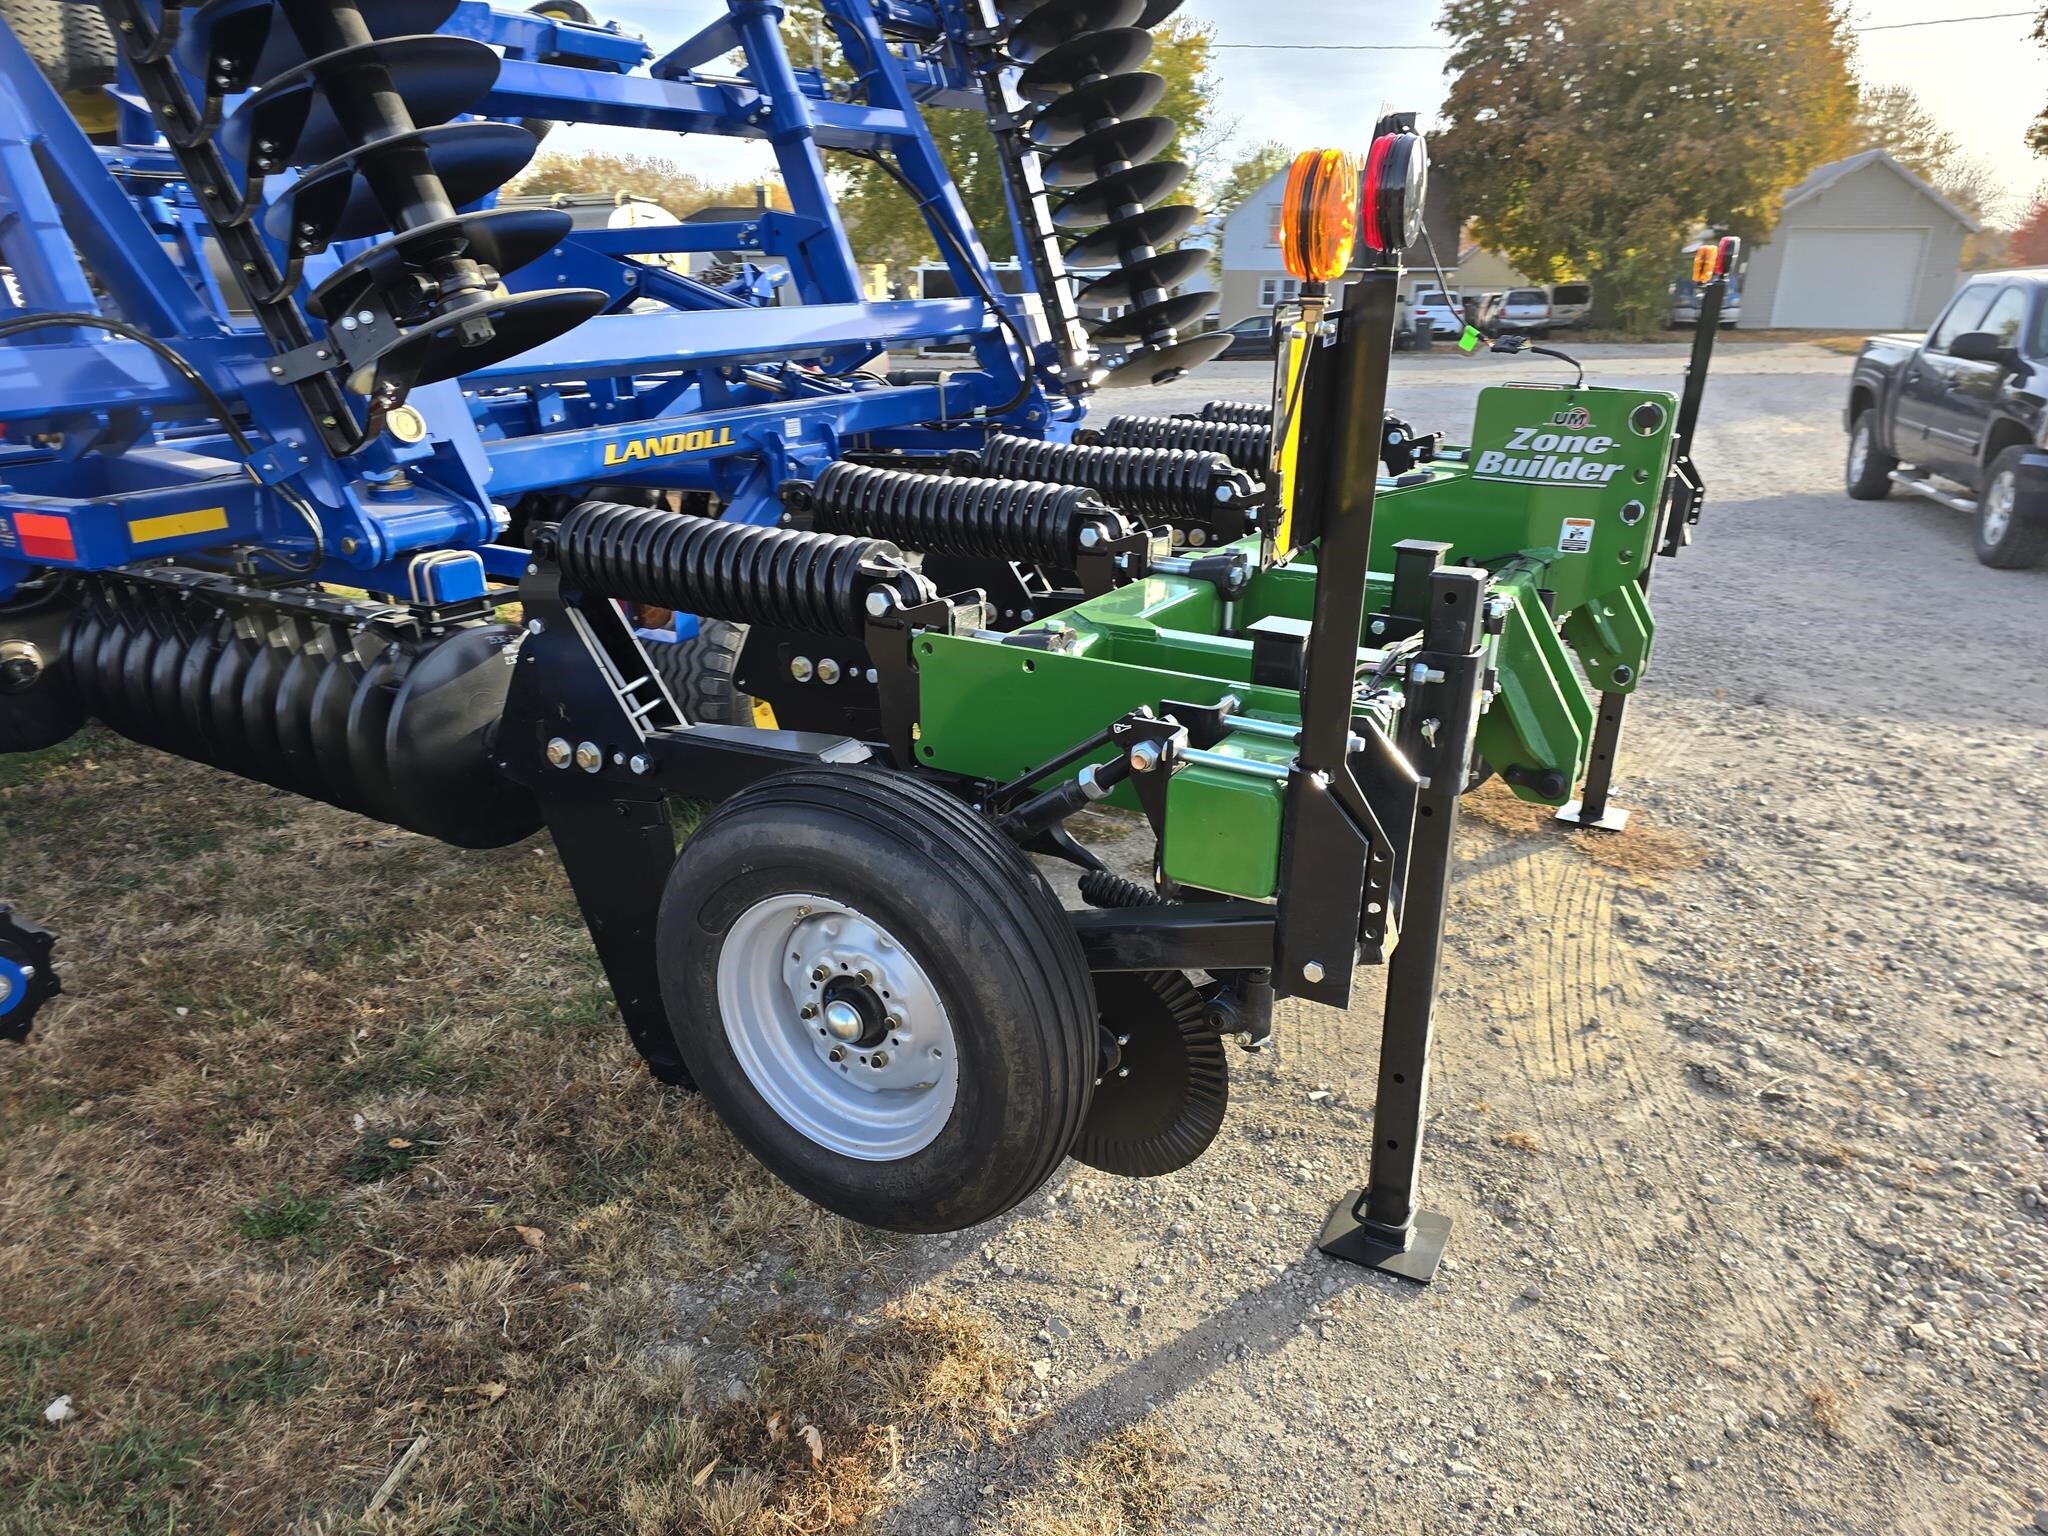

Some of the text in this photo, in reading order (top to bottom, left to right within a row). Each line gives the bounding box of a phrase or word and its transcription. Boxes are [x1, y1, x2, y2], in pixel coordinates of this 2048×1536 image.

[1552, 411, 1587, 426] UM
[604, 426, 736, 466] LANDOLL
[1504, 427, 1621, 455] Zone-
[1473, 450, 1625, 482] Builder
